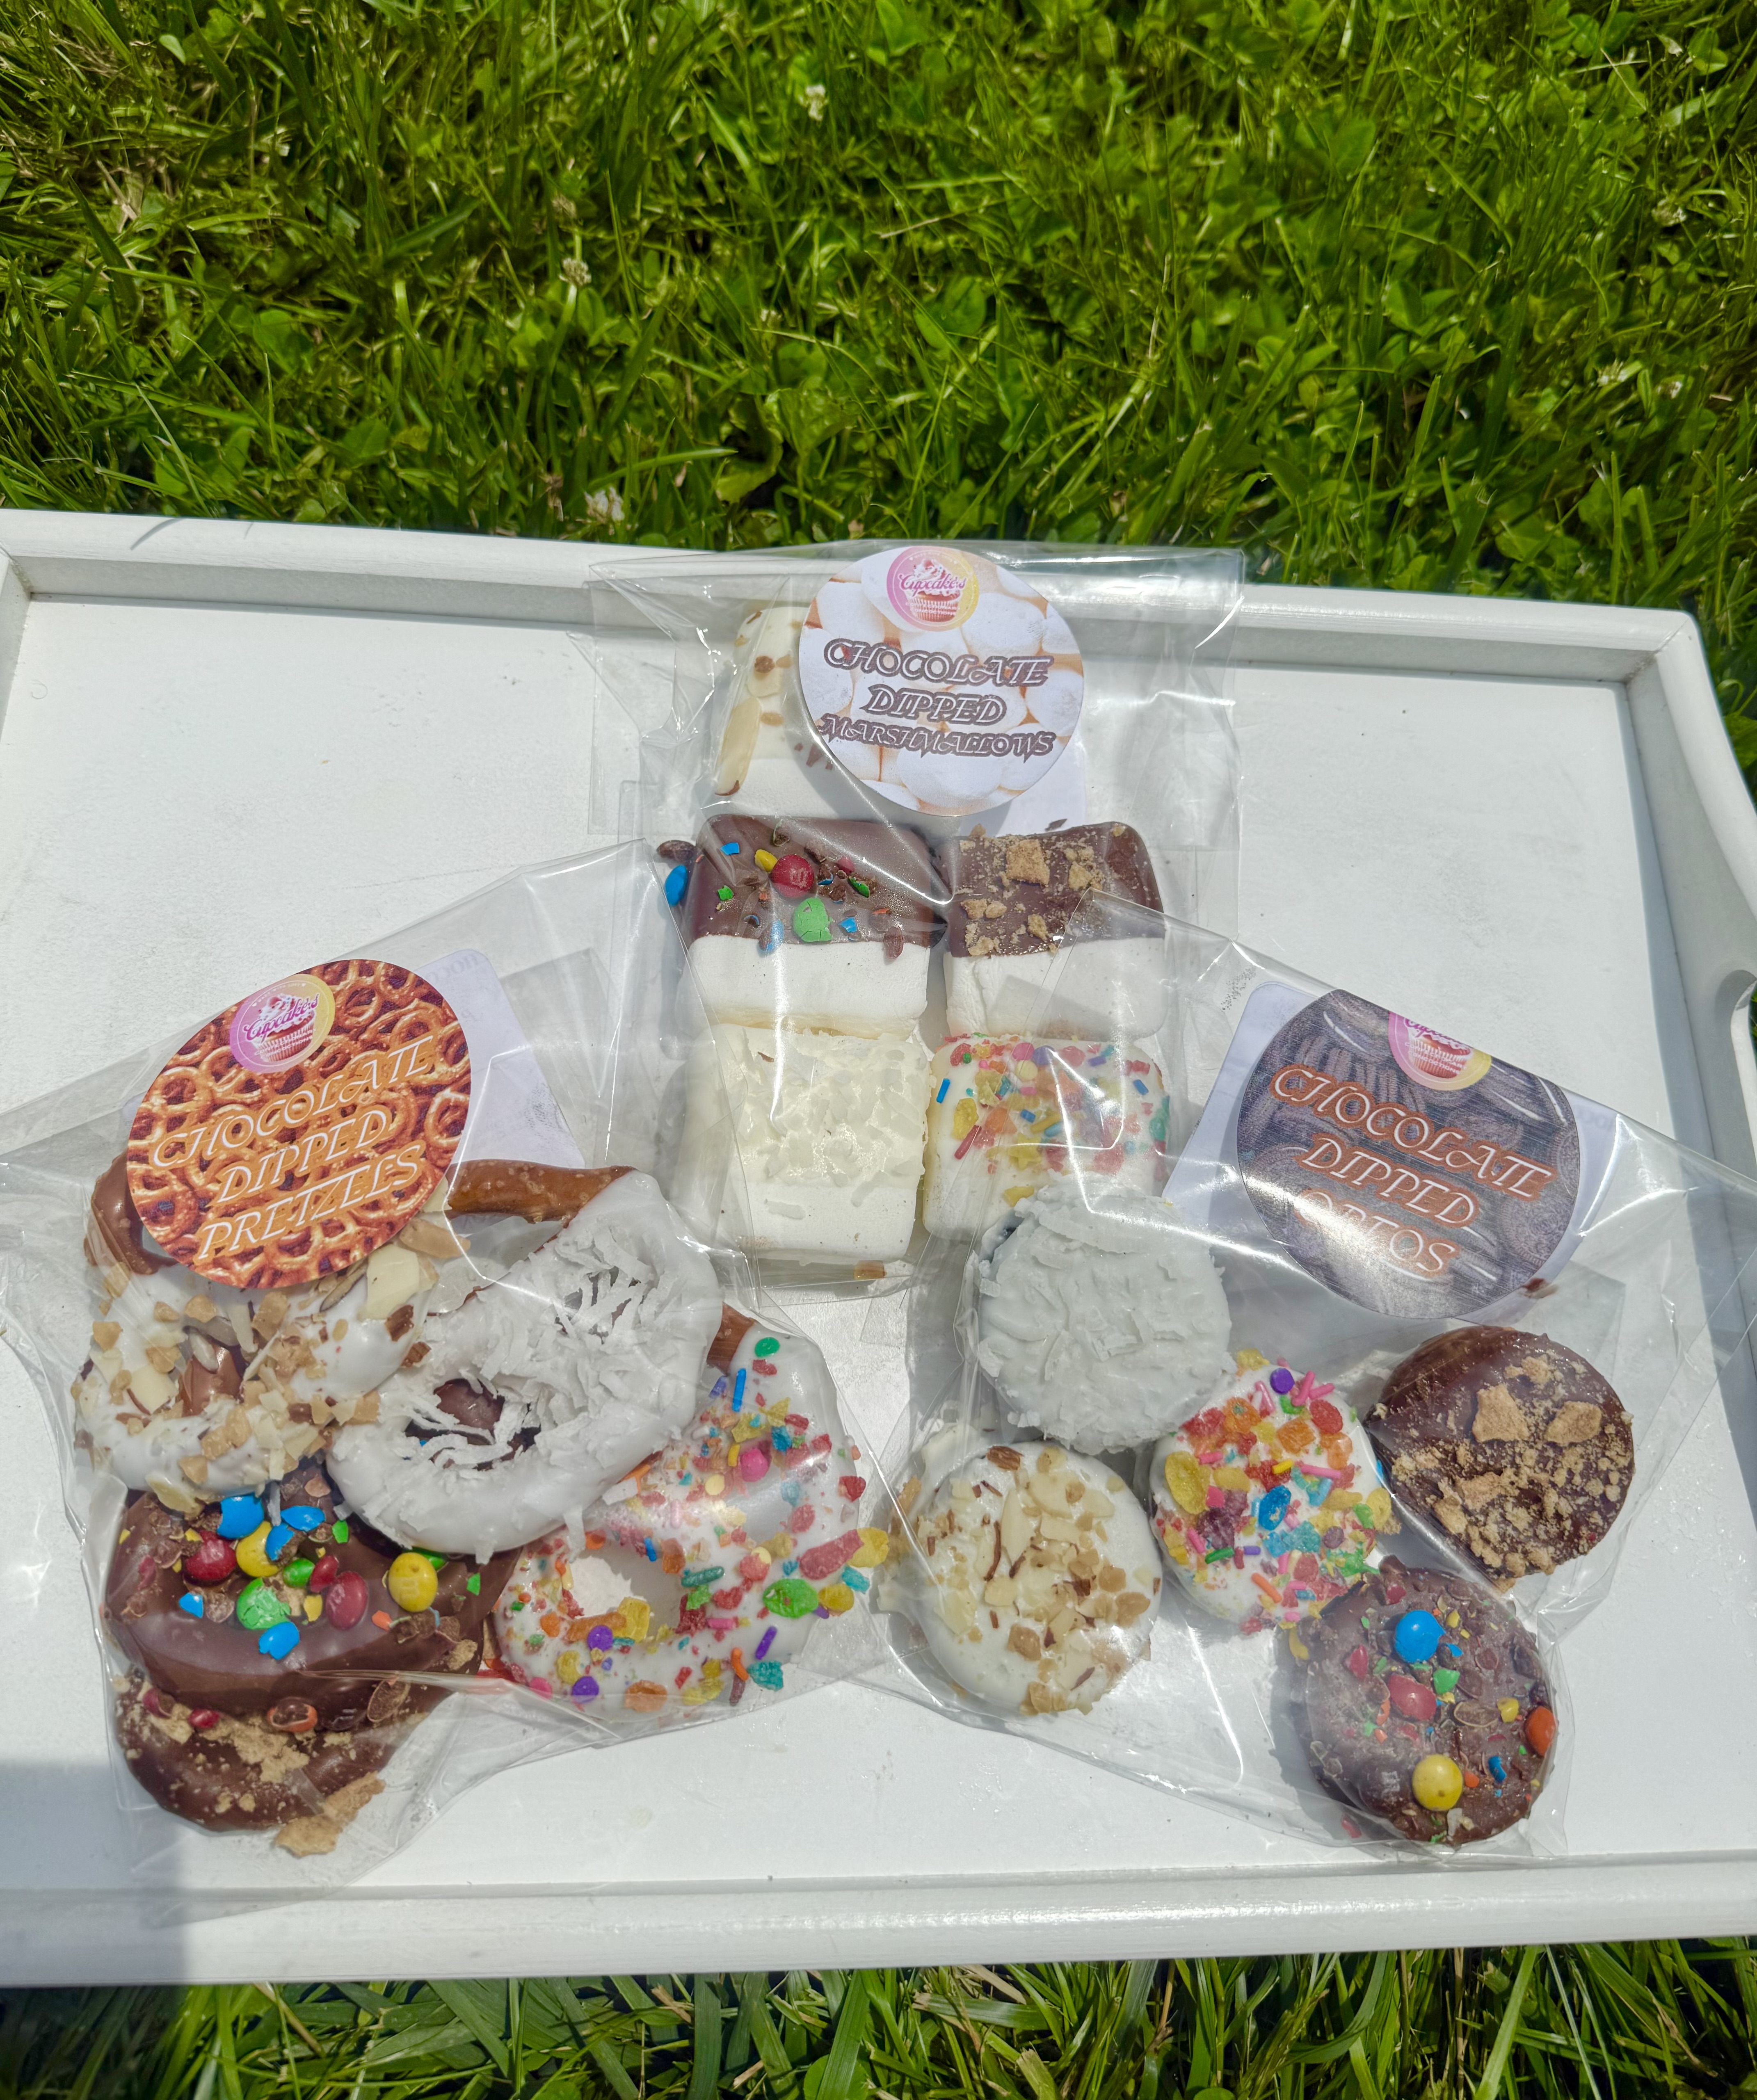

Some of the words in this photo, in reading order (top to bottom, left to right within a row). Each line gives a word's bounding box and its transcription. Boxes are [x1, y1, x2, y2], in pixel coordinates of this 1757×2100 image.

[825, 639, 1053, 686] CHOCOLATE
[861, 685, 1006, 725] DIPPED
[818, 714, 1056, 761] MARSHMALLOWS
[153, 1034, 434, 1167] CHOCOLATE
[1274, 1068, 1552, 1198] CHOCOLATE
[216, 1109, 388, 1203] DIPPED
[1301, 1137, 1474, 1224] DIPPED
[197, 1144, 420, 1260] PRETZELS
